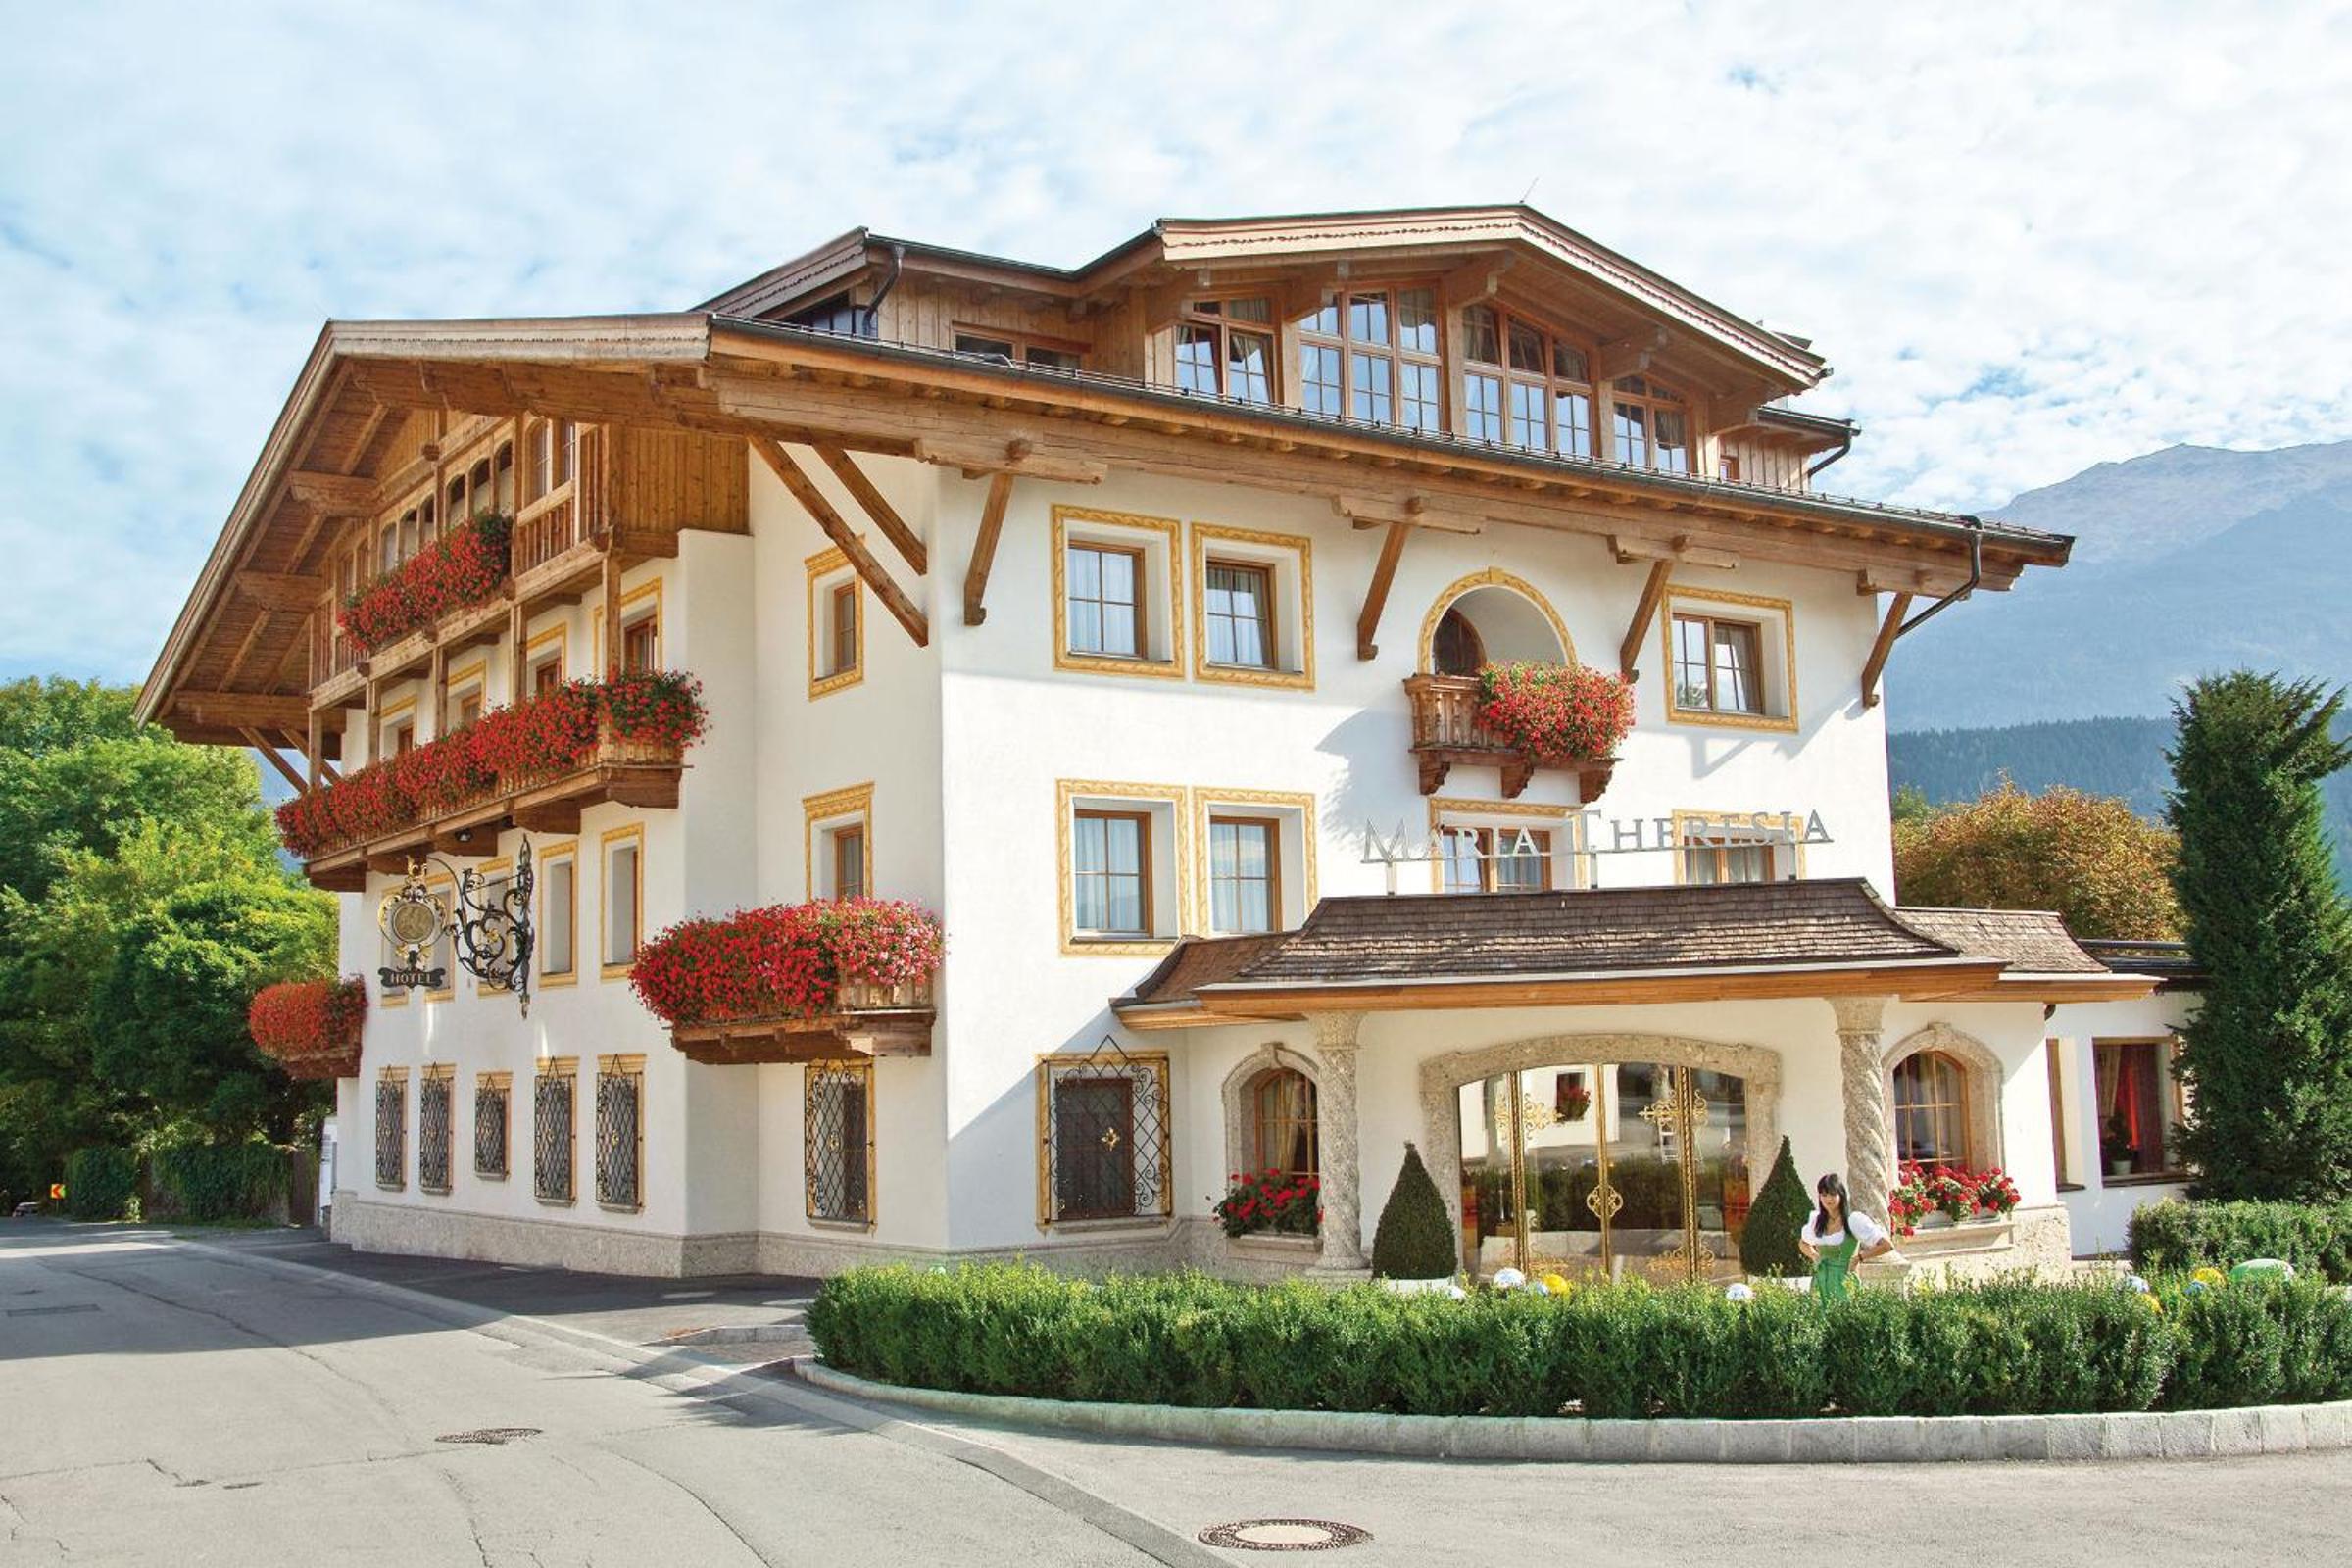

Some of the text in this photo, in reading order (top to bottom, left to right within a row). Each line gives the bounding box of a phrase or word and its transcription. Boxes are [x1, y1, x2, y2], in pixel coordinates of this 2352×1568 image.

[1362, 808, 1834, 862] MARIA THERESIA
[390, 972, 433, 984] HOTEL
